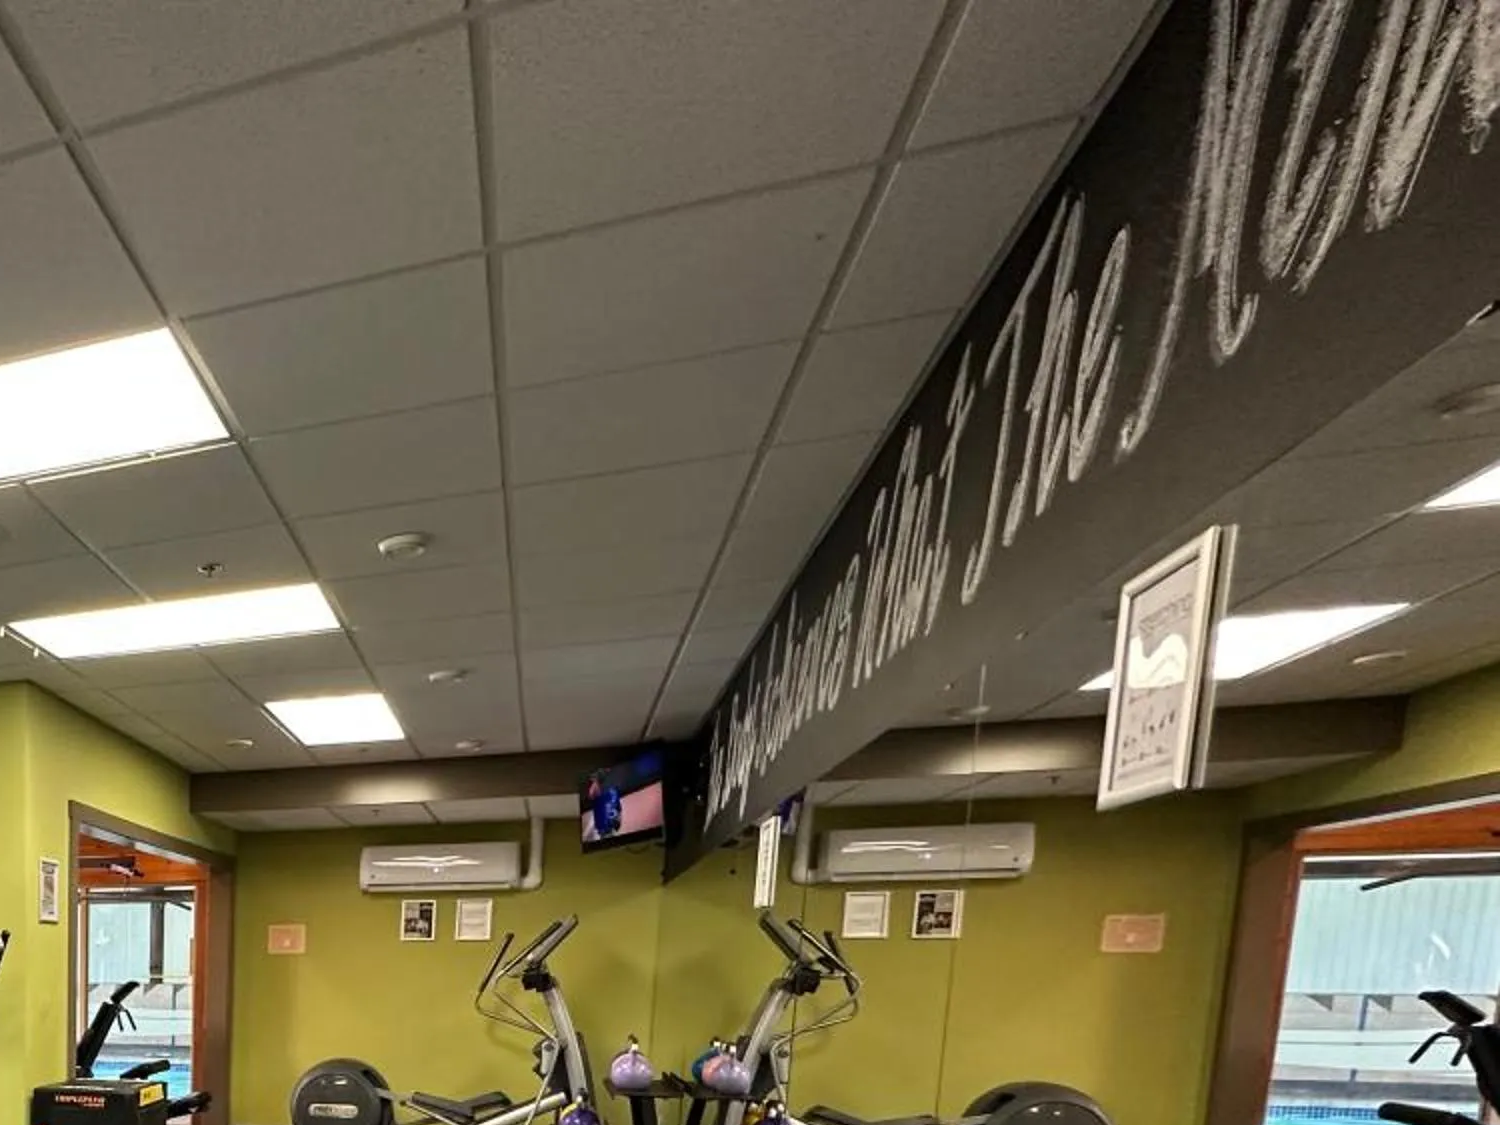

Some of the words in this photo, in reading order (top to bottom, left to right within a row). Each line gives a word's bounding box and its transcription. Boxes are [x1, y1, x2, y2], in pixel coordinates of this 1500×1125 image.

[852, 341, 976, 688] What
[960, 188, 1130, 606] The
[1114, 0, 1500, 463] Min
